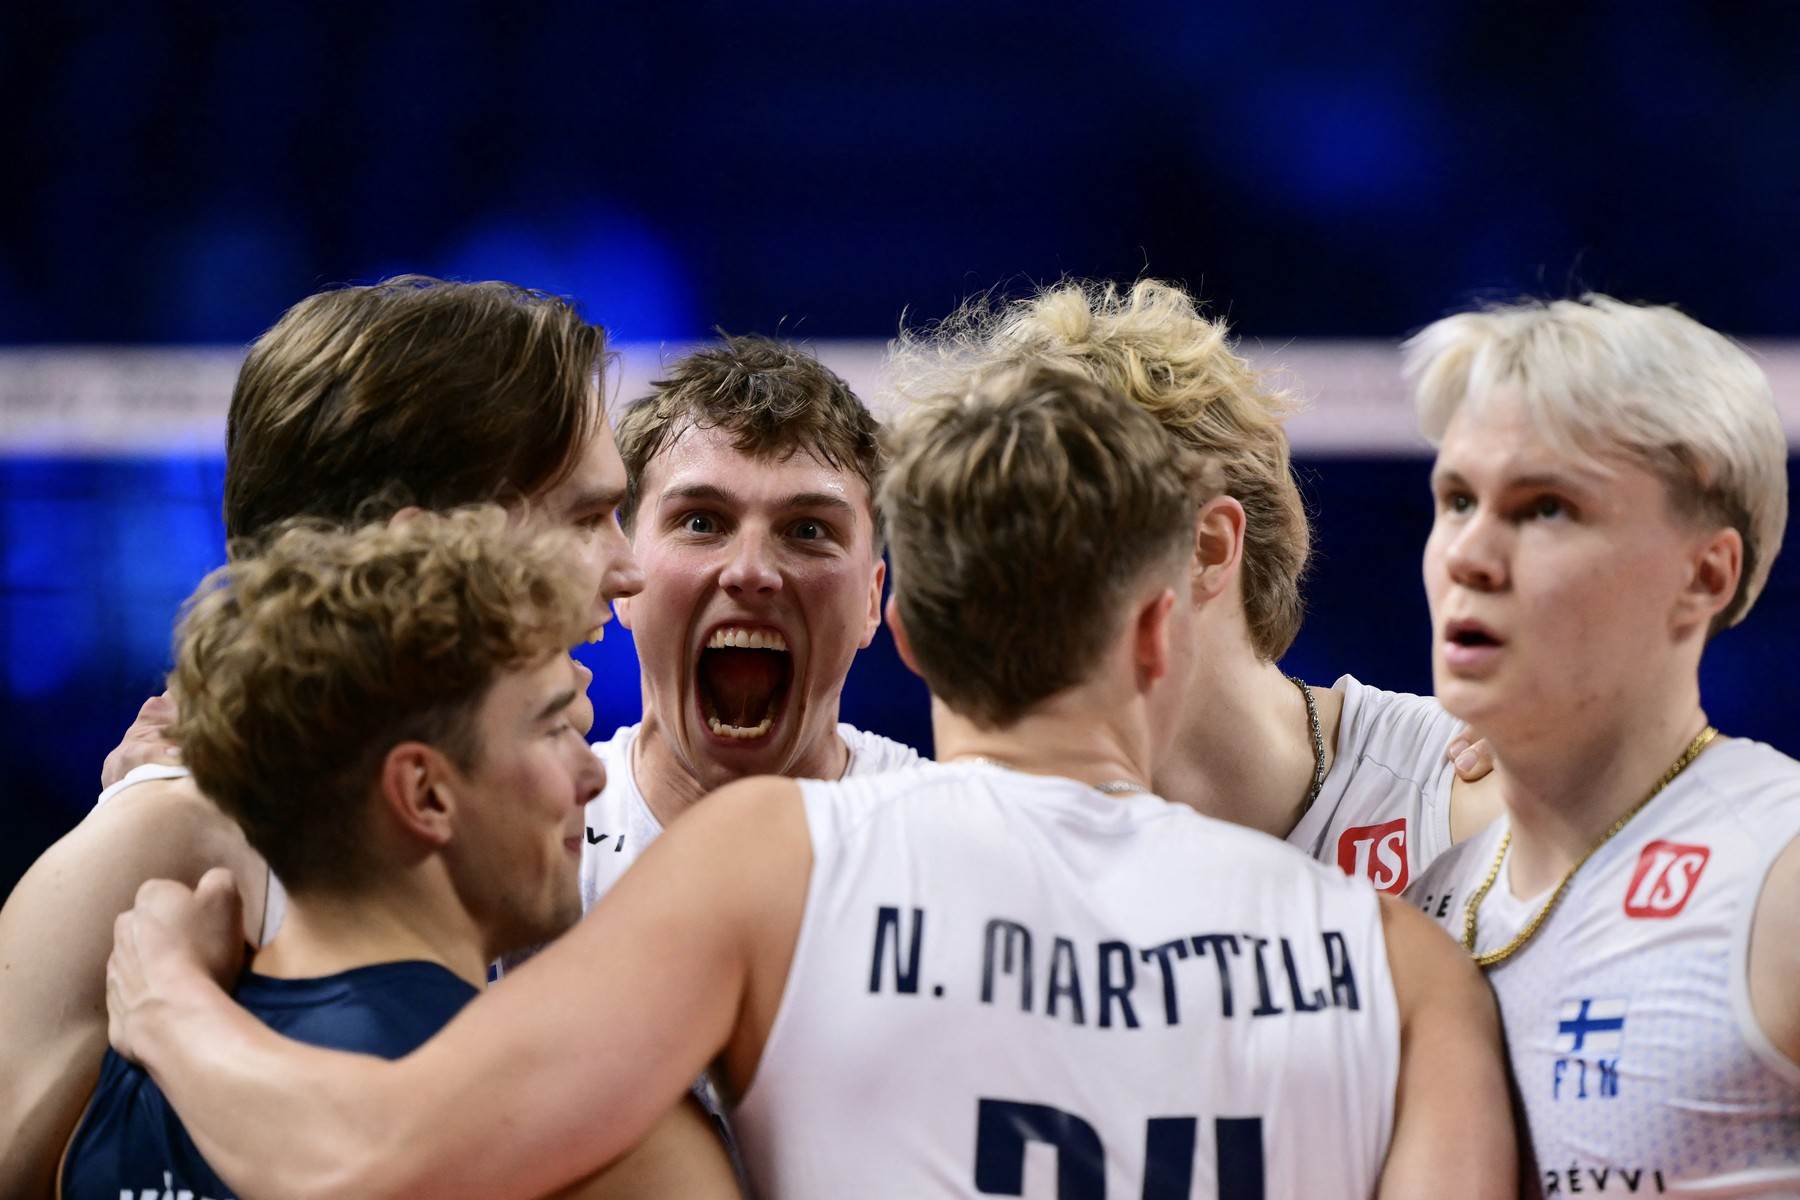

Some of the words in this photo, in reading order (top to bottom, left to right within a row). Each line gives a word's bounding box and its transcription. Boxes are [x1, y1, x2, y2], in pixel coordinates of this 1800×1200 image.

[1629, 851, 1706, 911] IS
[869, 906, 944, 996] N.
[980, 918, 1361, 1028] MARTTILA
[1552, 1058, 1619, 1100] FIN
